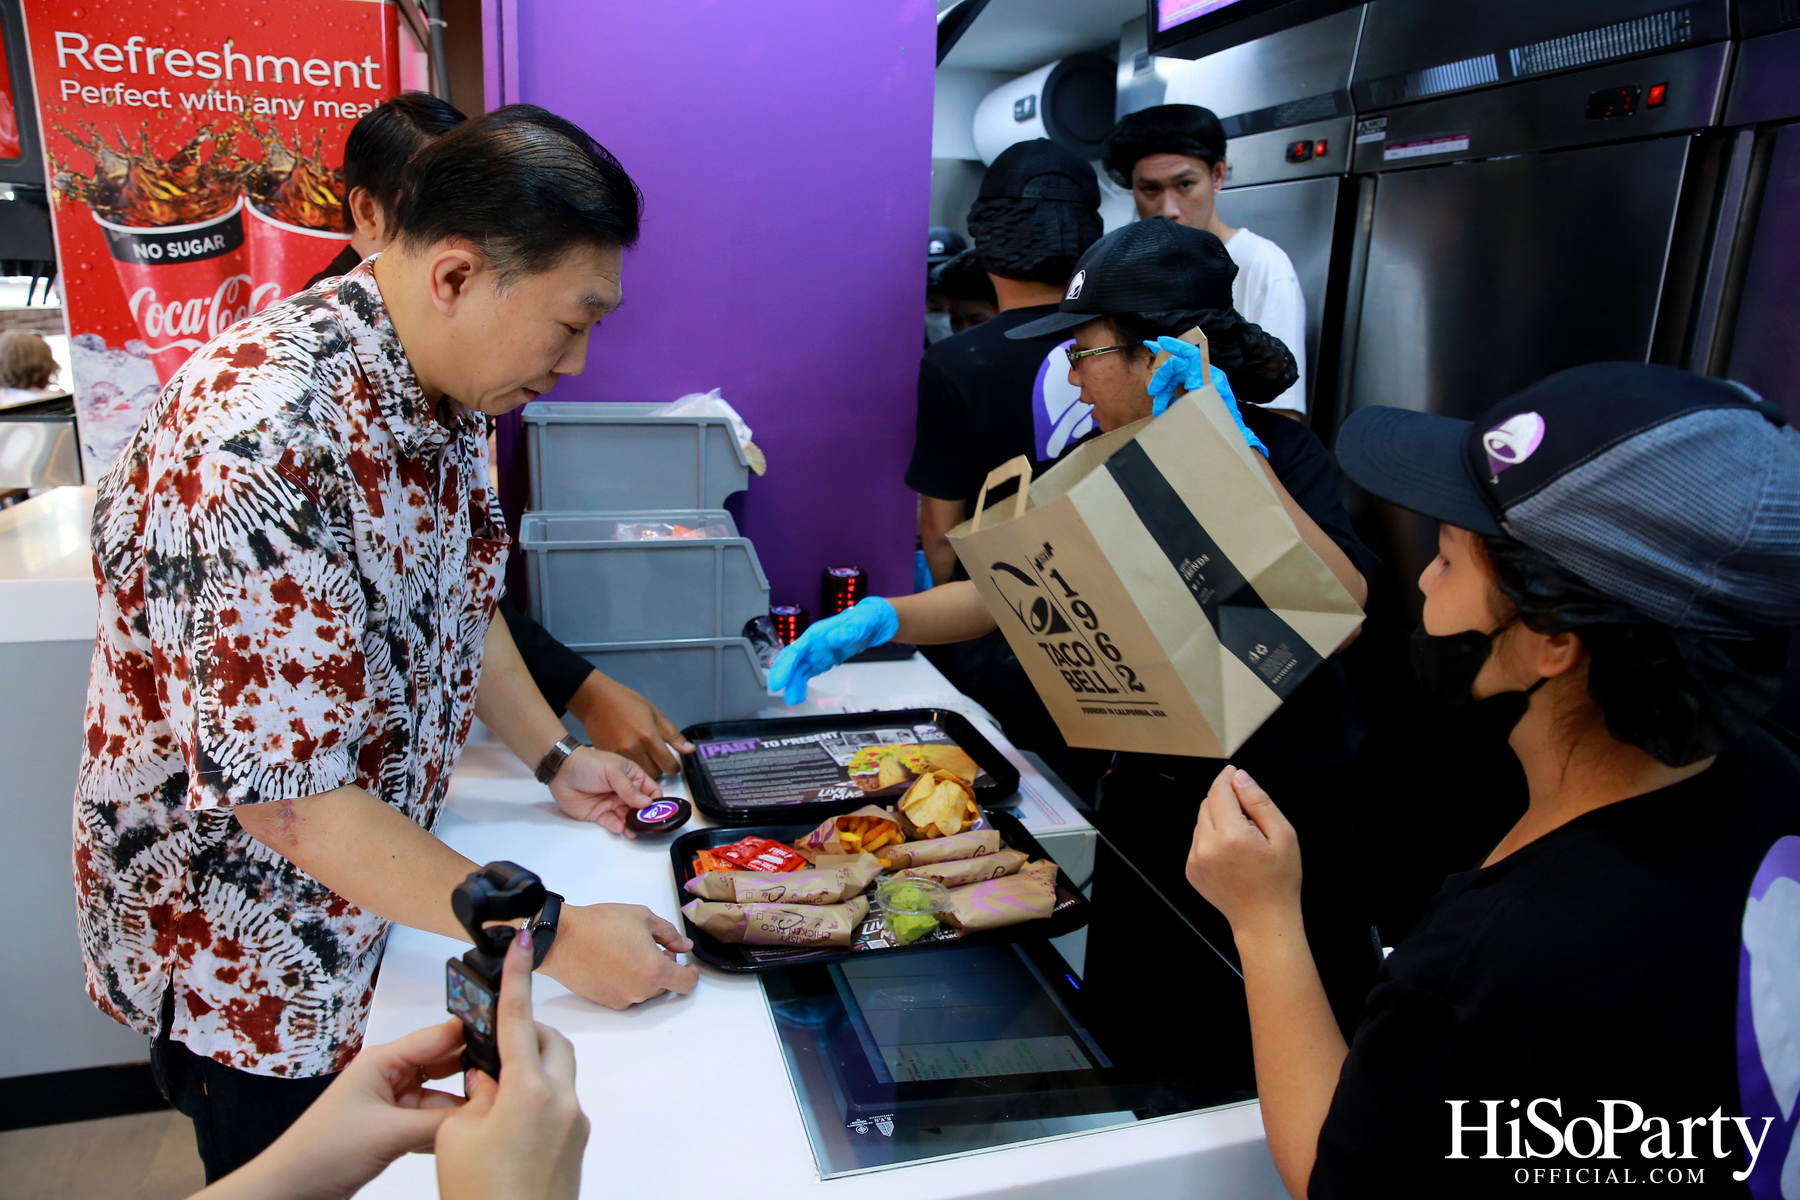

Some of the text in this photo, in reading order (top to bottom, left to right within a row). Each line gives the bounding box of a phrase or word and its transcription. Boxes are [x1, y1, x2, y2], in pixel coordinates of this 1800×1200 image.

[54, 30, 382, 90] Refreshment
[59, 79, 172, 109] Perfect
[179, 89, 244, 113] with
[252, 96, 305, 121] any
[133, 233, 226, 260] NO SUGAR
[1037, 641, 1096, 668] TACO
[1059, 669, 1120, 694] BELL
[706, 732, 839, 756] PAST TO PRESENT
[761, 923, 832, 939] CHICKEN TACO
